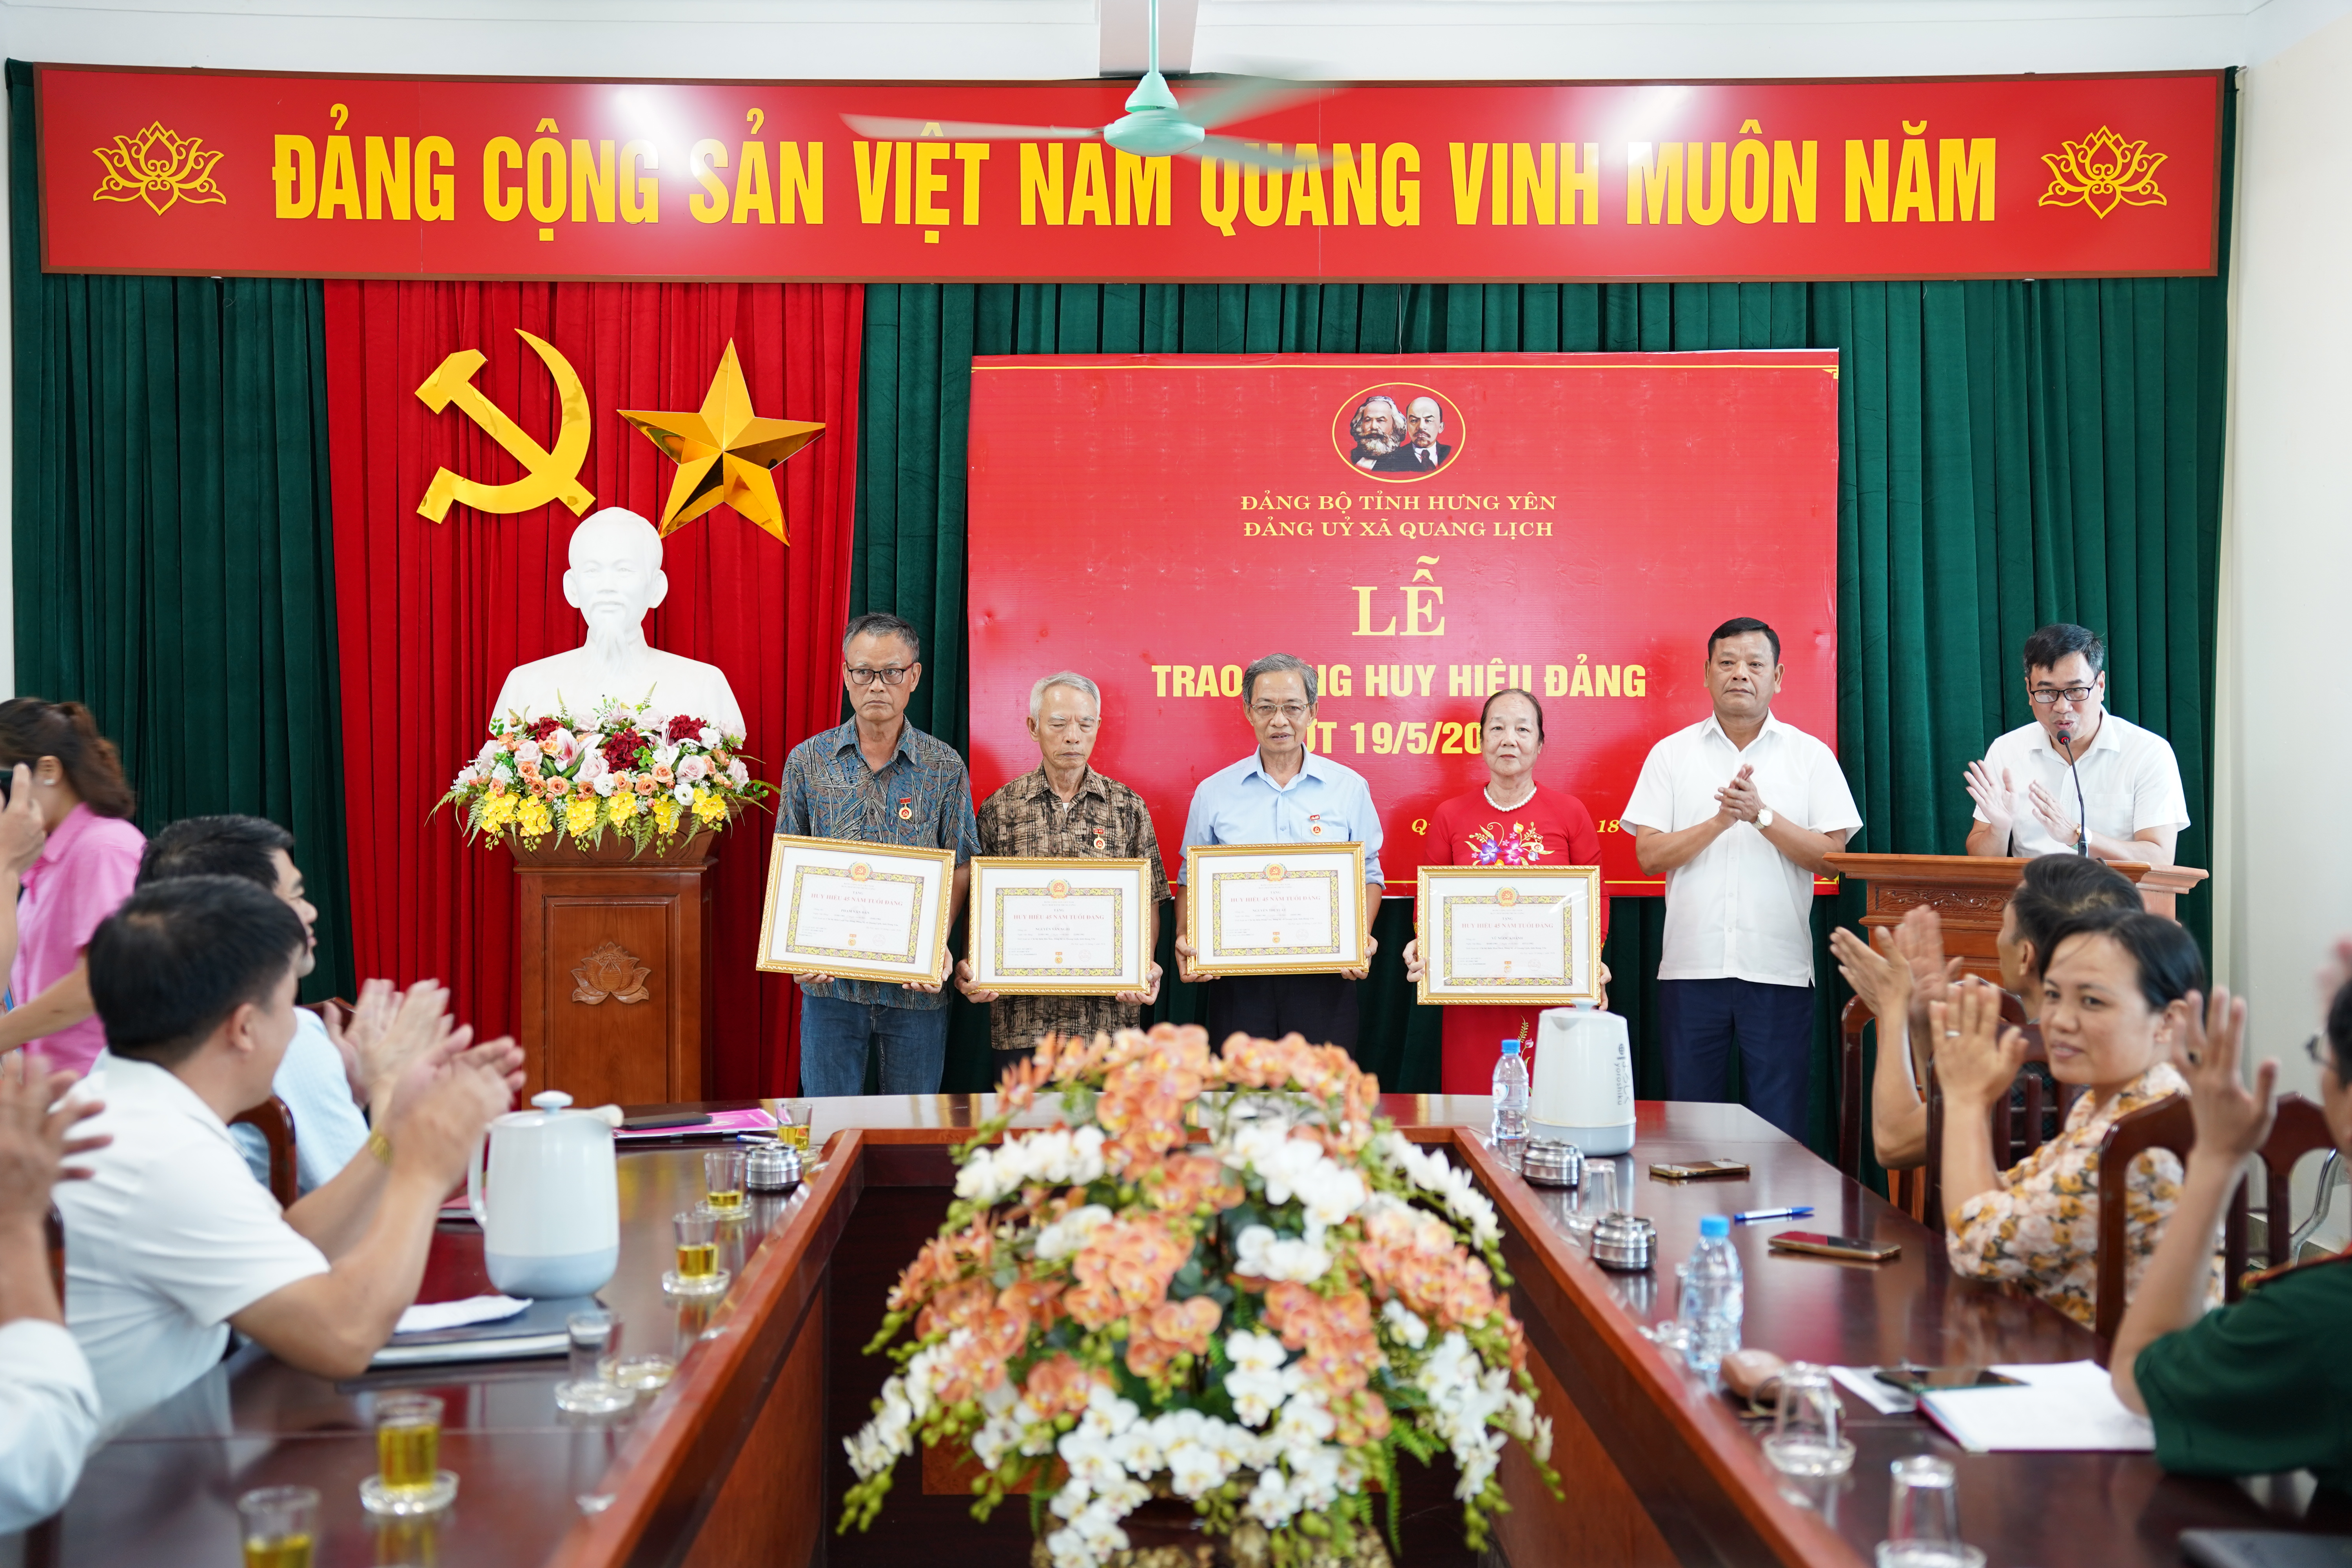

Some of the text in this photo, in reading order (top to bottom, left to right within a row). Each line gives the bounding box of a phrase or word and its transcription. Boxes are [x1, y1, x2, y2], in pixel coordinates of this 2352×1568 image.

[272, 103, 1996, 243] ĐẢNG CỘNG SẢN VIỆT NAM QUANG VINH MUÔN NĂM
[1241, 490, 1557, 514] ĐẢNG BỘ TỈNH HƯNG YÊN
[1243, 516, 1553, 540] ĐẢNG UỶ XÃ QUANG LỊCH
[1352, 555, 1445, 635] LỄ
[1152, 664, 1243, 697] TRAO
[1365, 664, 1436, 697] HUY
[1544, 653, 1646, 697] ĐẢNG
[1597, 819, 1620, 833] 18
[1614, 1063, 1623, 1105] yoroshiku
